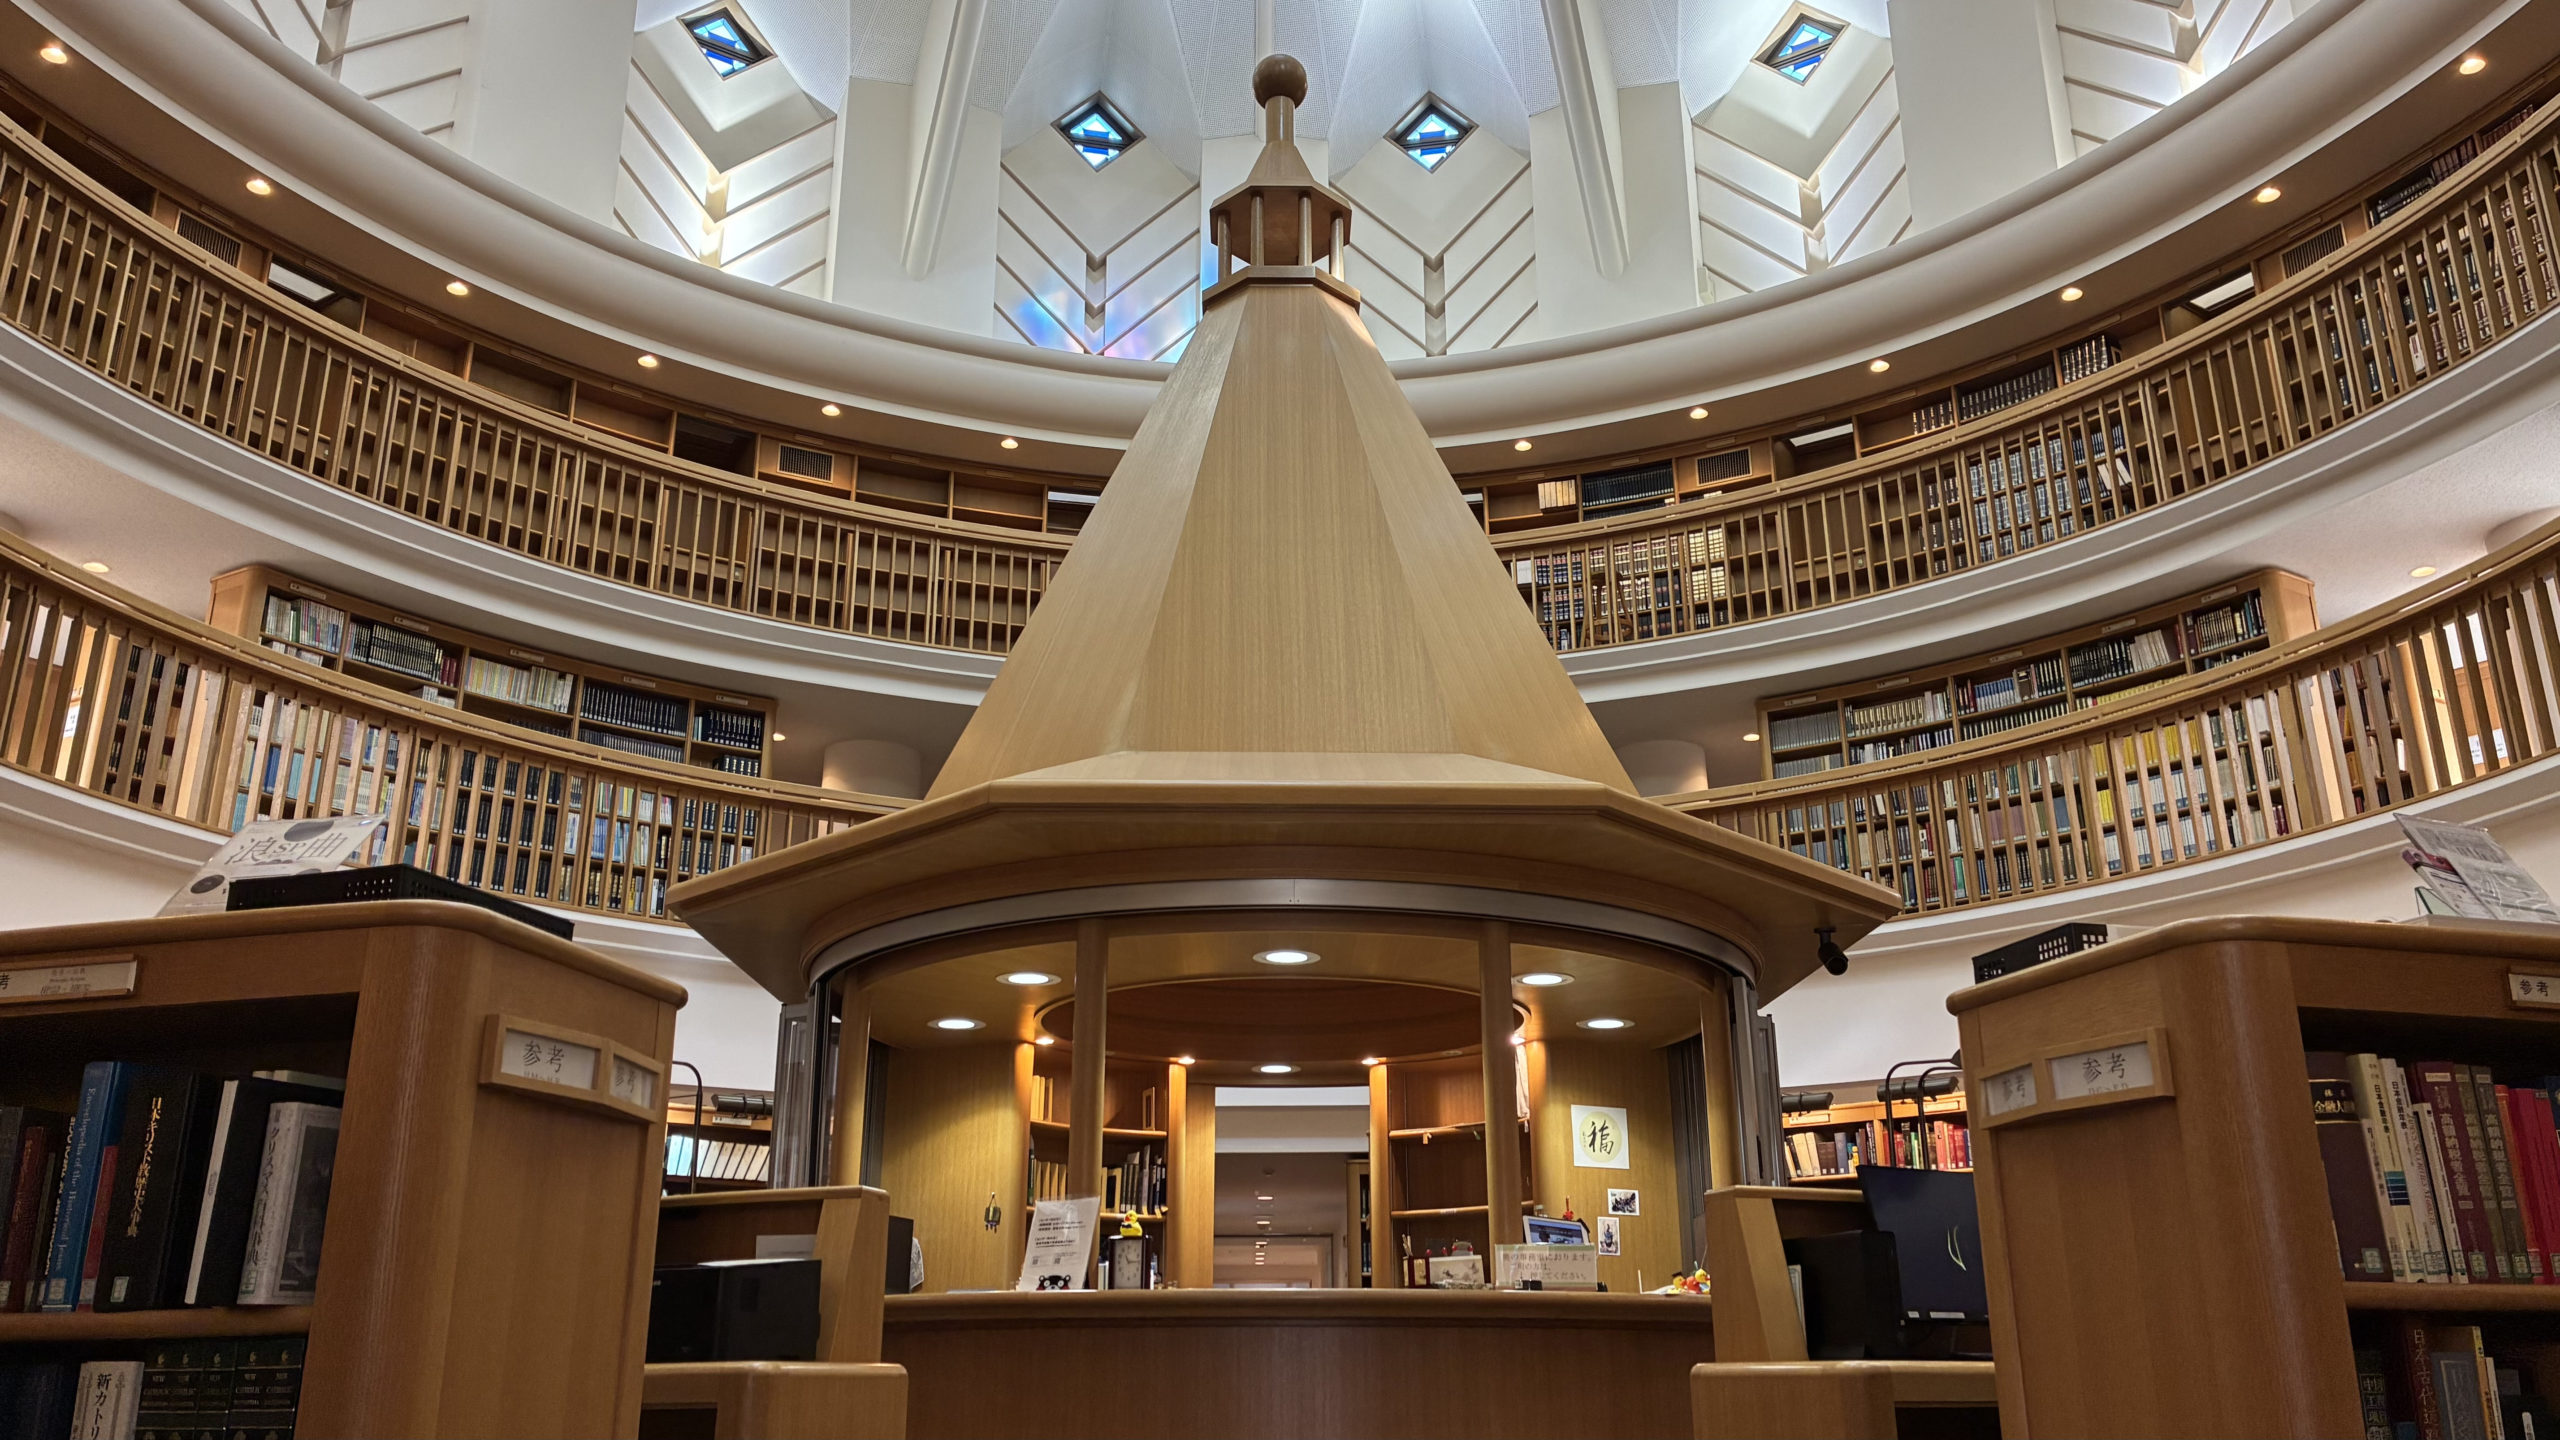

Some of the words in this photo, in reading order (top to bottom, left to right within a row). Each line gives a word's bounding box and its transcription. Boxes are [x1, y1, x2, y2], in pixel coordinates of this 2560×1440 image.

[2519, 978, 2549, 997] 参考
[522, 1040, 566, 1074] 参考
[2082, 1052, 2126, 1084] 参考
